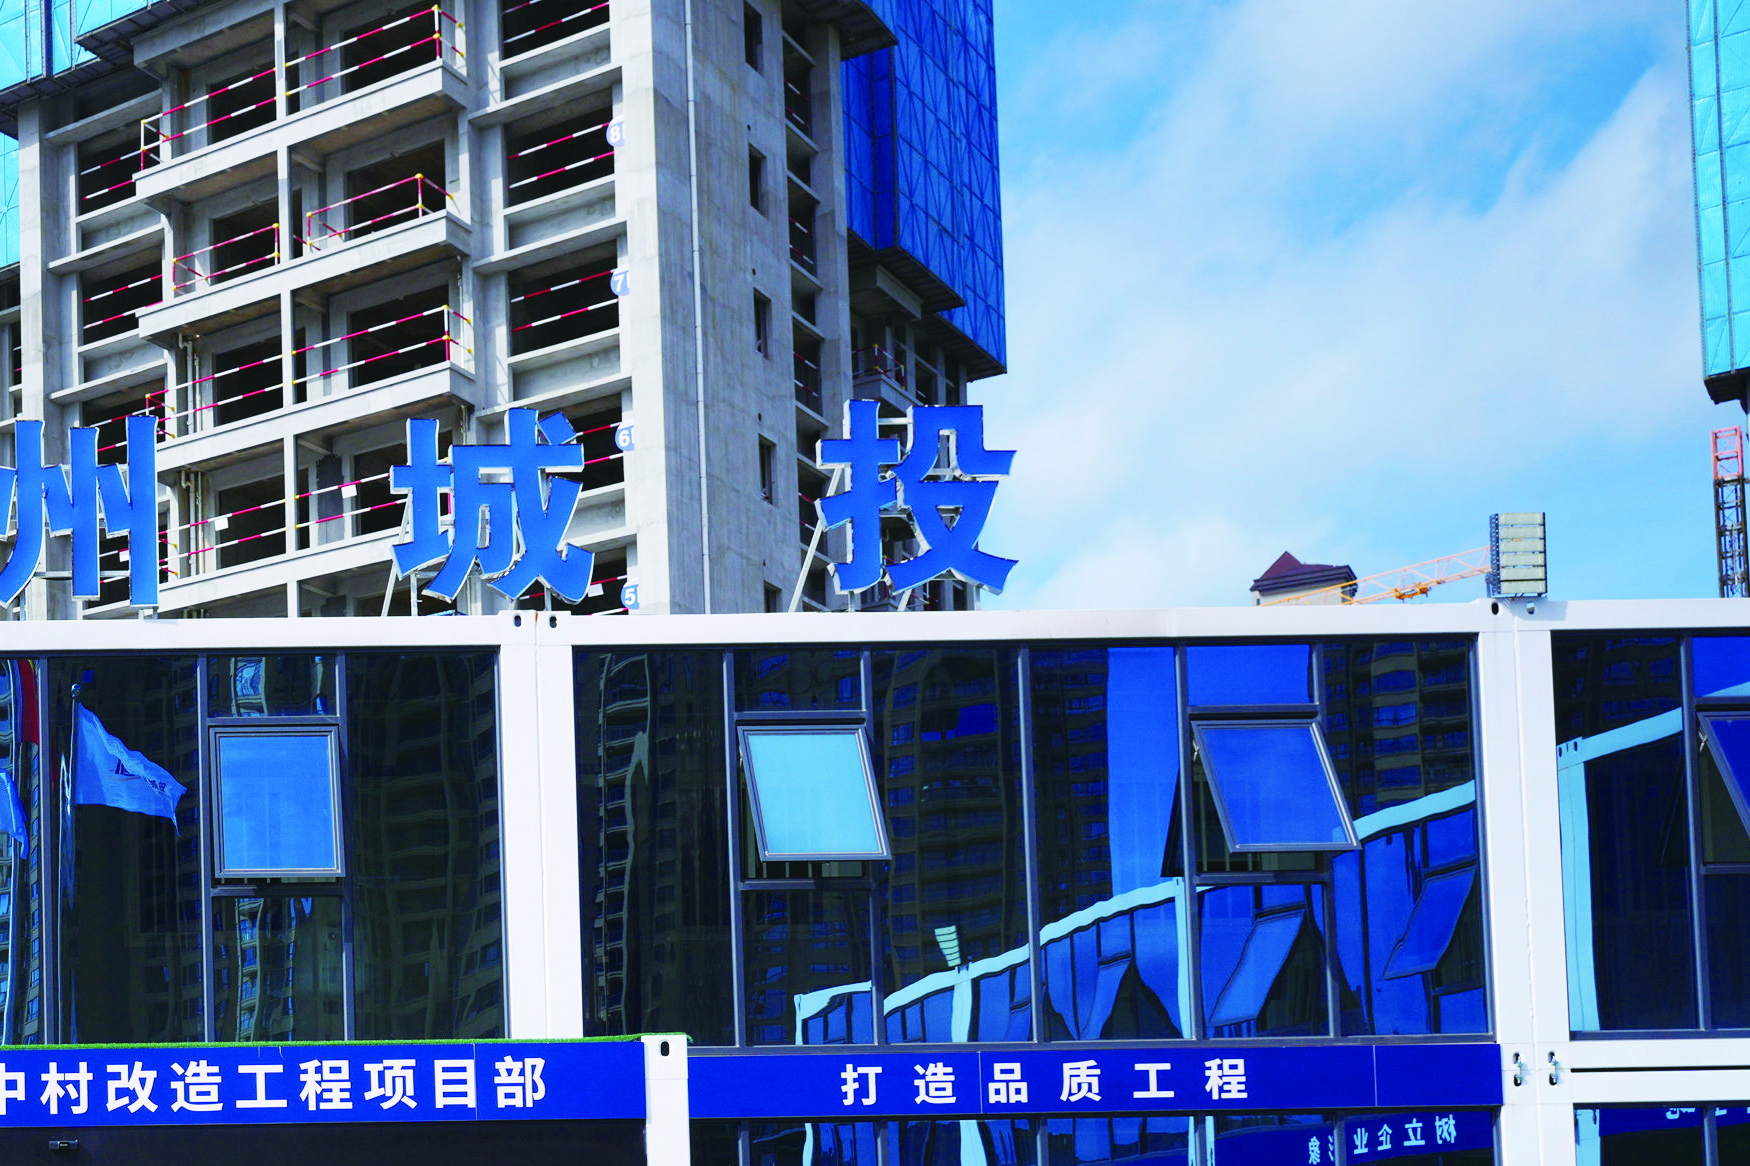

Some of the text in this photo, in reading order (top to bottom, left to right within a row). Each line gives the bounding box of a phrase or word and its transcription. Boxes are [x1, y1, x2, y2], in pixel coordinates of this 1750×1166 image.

[840, 1058, 1248, 1106] 打造品质工程
